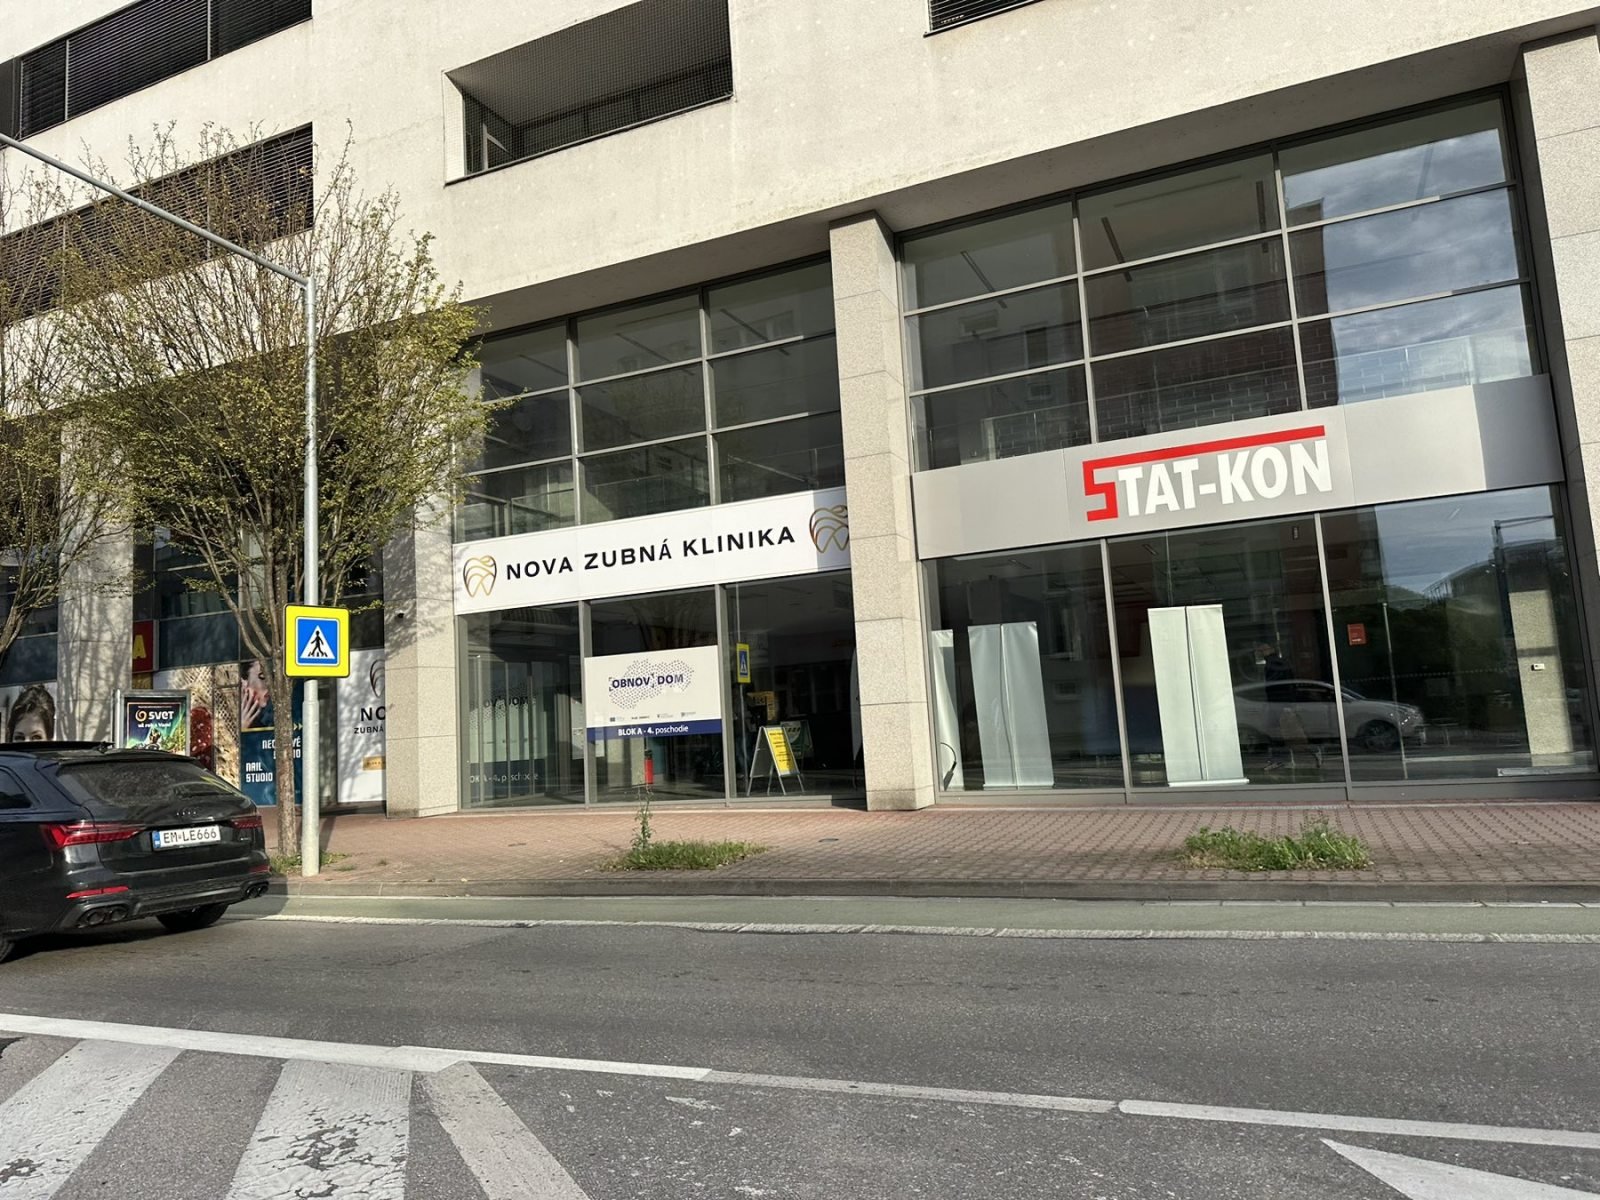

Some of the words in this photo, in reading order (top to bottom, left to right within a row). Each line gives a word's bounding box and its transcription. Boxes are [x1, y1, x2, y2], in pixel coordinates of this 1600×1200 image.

[1082, 425, 1332, 521] STAT-KON
[506, 556, 573, 580] NOVA
[584, 538, 672, 570] ZUBNÁ
[682, 526, 796, 557] KLINIKA
[612, 676, 651, 689] OBNOV
[657, 673, 684, 685] DOM
[360, 706, 385, 721] NO
[618, 727, 636, 736] BLOK
[637, 727, 643, 735] A
[655, 725, 689, 735] poschodie
[245, 762, 263, 772] NAIL
[245, 772, 274, 783] STUDIO
